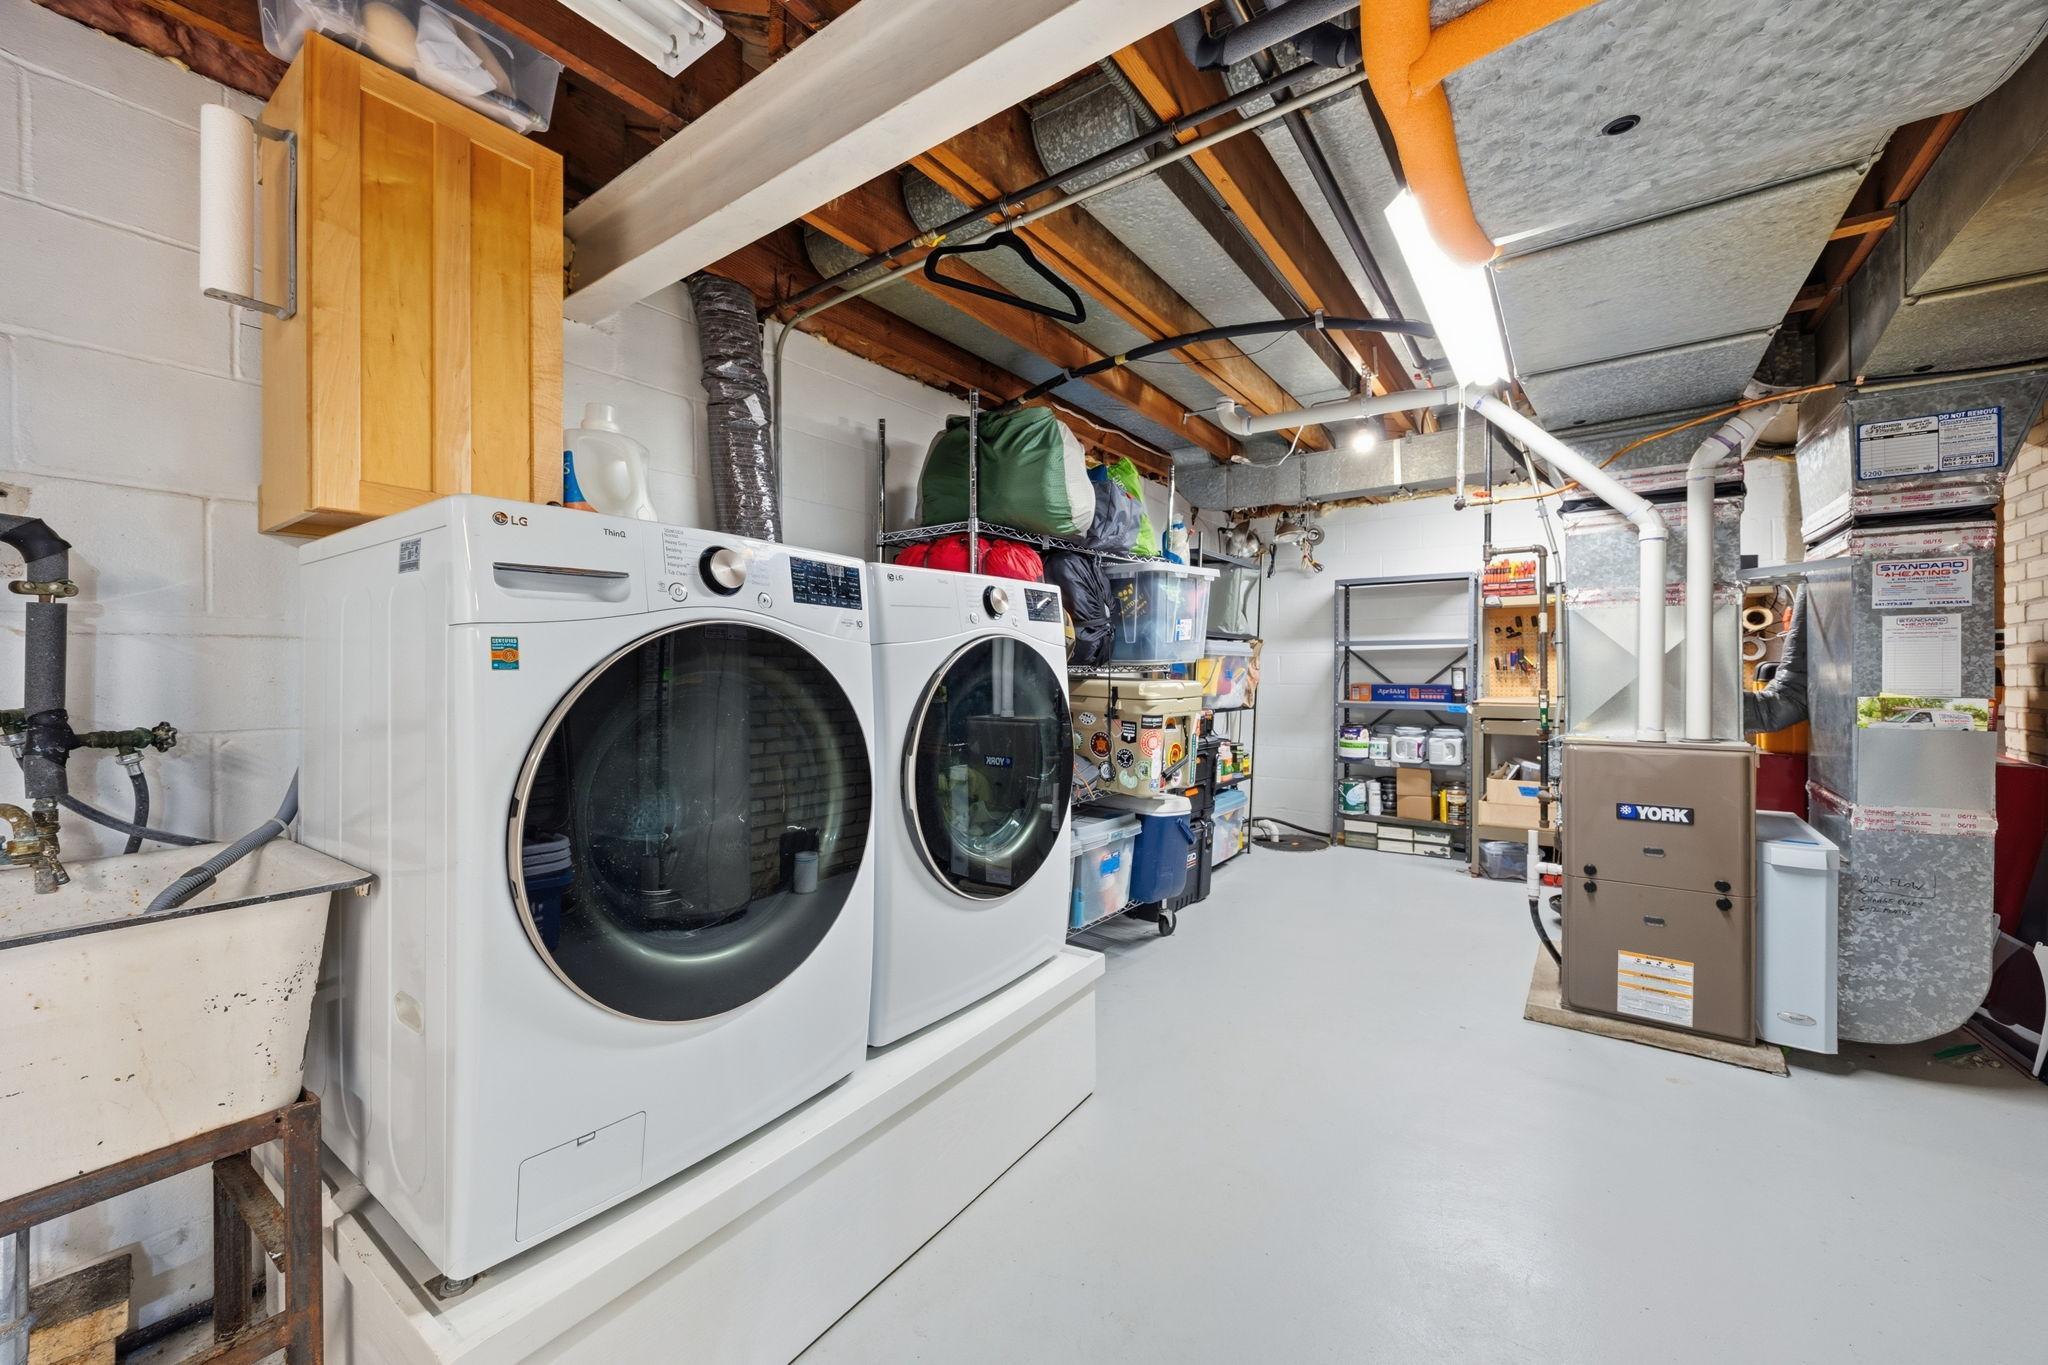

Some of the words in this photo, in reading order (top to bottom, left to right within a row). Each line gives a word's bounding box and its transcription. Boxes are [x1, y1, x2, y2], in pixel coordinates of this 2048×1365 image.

[1967, 407, 1998, 417] REMOVE
[510, 515, 528, 527] LG
[603, 528, 626, 539] ThinQ
[1880, 561, 1965, 572] STANDARD
[1892, 569, 1952, 577] HEATING
[1635, 805, 1689, 823] YORK
[1862, 875, 1884, 886] AIR
[1890, 878, 1926, 890] FLOW
